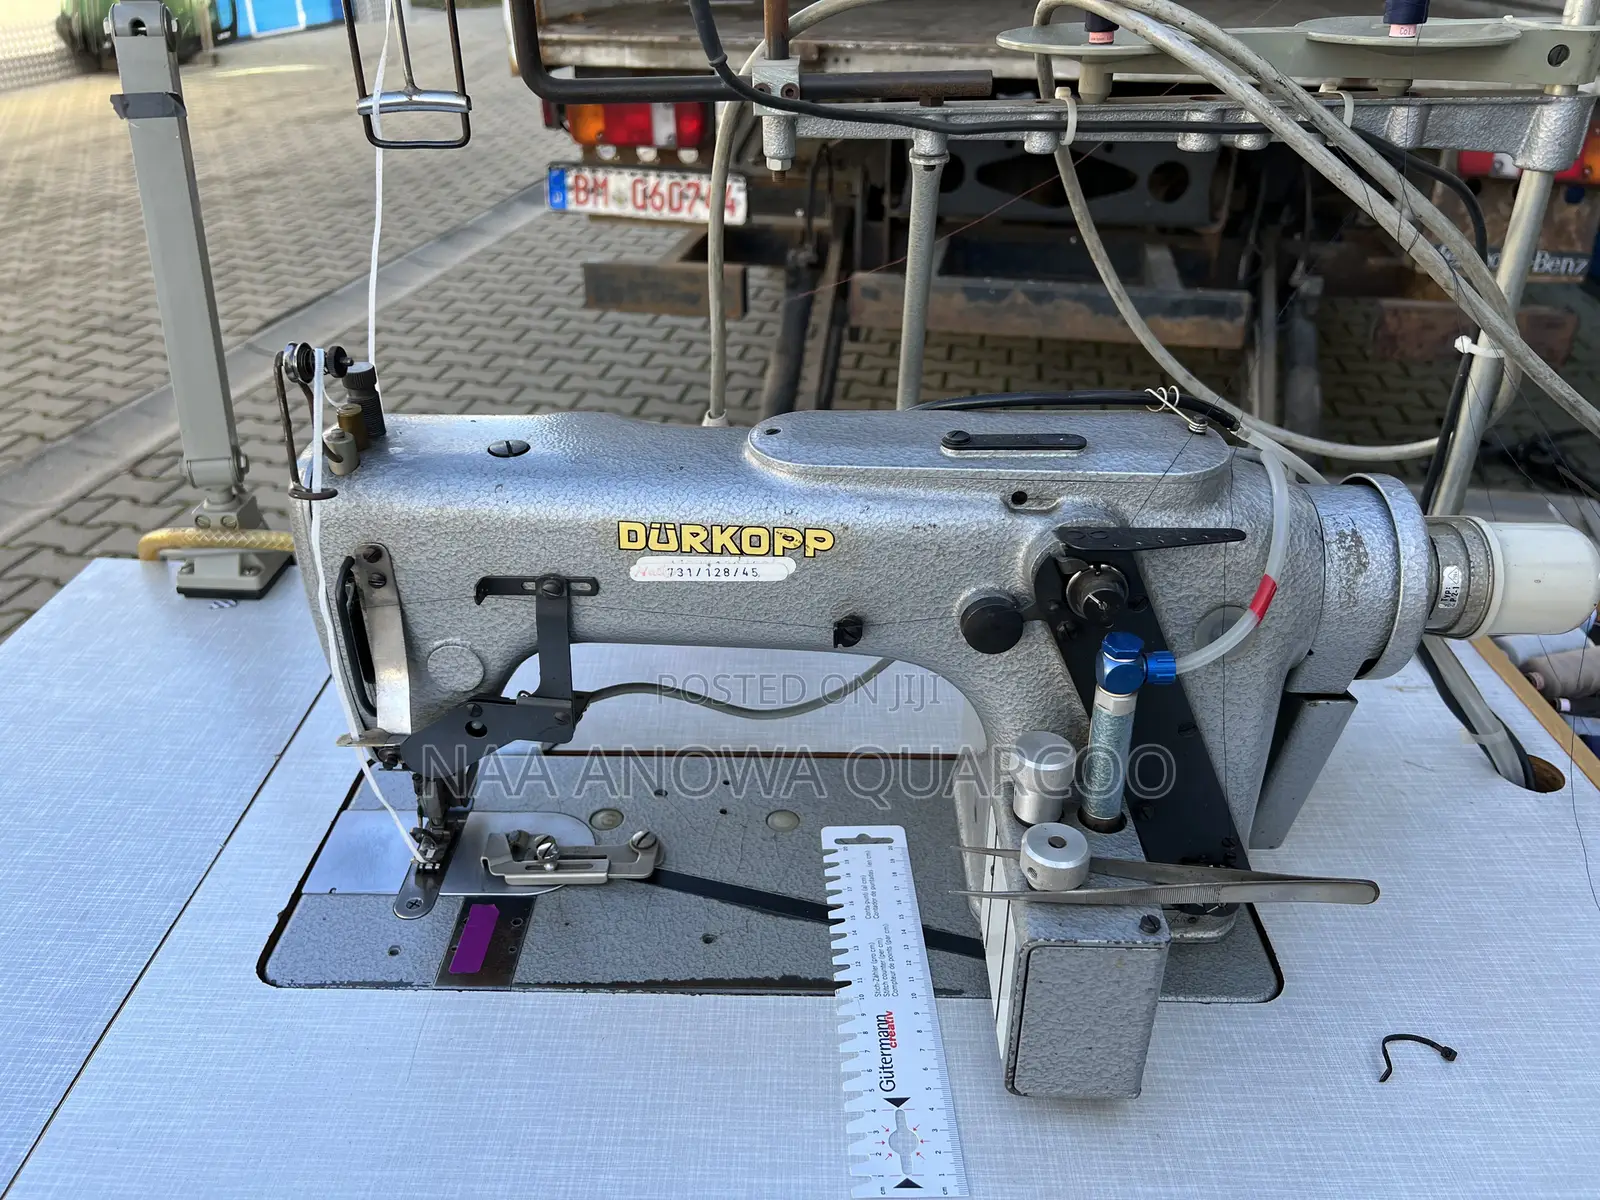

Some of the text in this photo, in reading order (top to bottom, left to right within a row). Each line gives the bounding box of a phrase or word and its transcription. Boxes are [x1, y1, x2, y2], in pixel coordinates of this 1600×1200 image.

[574, 174, 736, 216] BM 06074
[618, 520, 835, 558] DÜRKOPP
[667, 567, 758, 578] 731/128/45
[886, 946, 895, 962] points
[888, 962, 895, 970] de
[889, 970, 899, 997] Compteur
[886, 1010, 897, 1048] creativ
[876, 1014, 896, 1093] Gütermann
[881, 1186, 886, 1196] cm
[942, 1186, 948, 1196] cm
